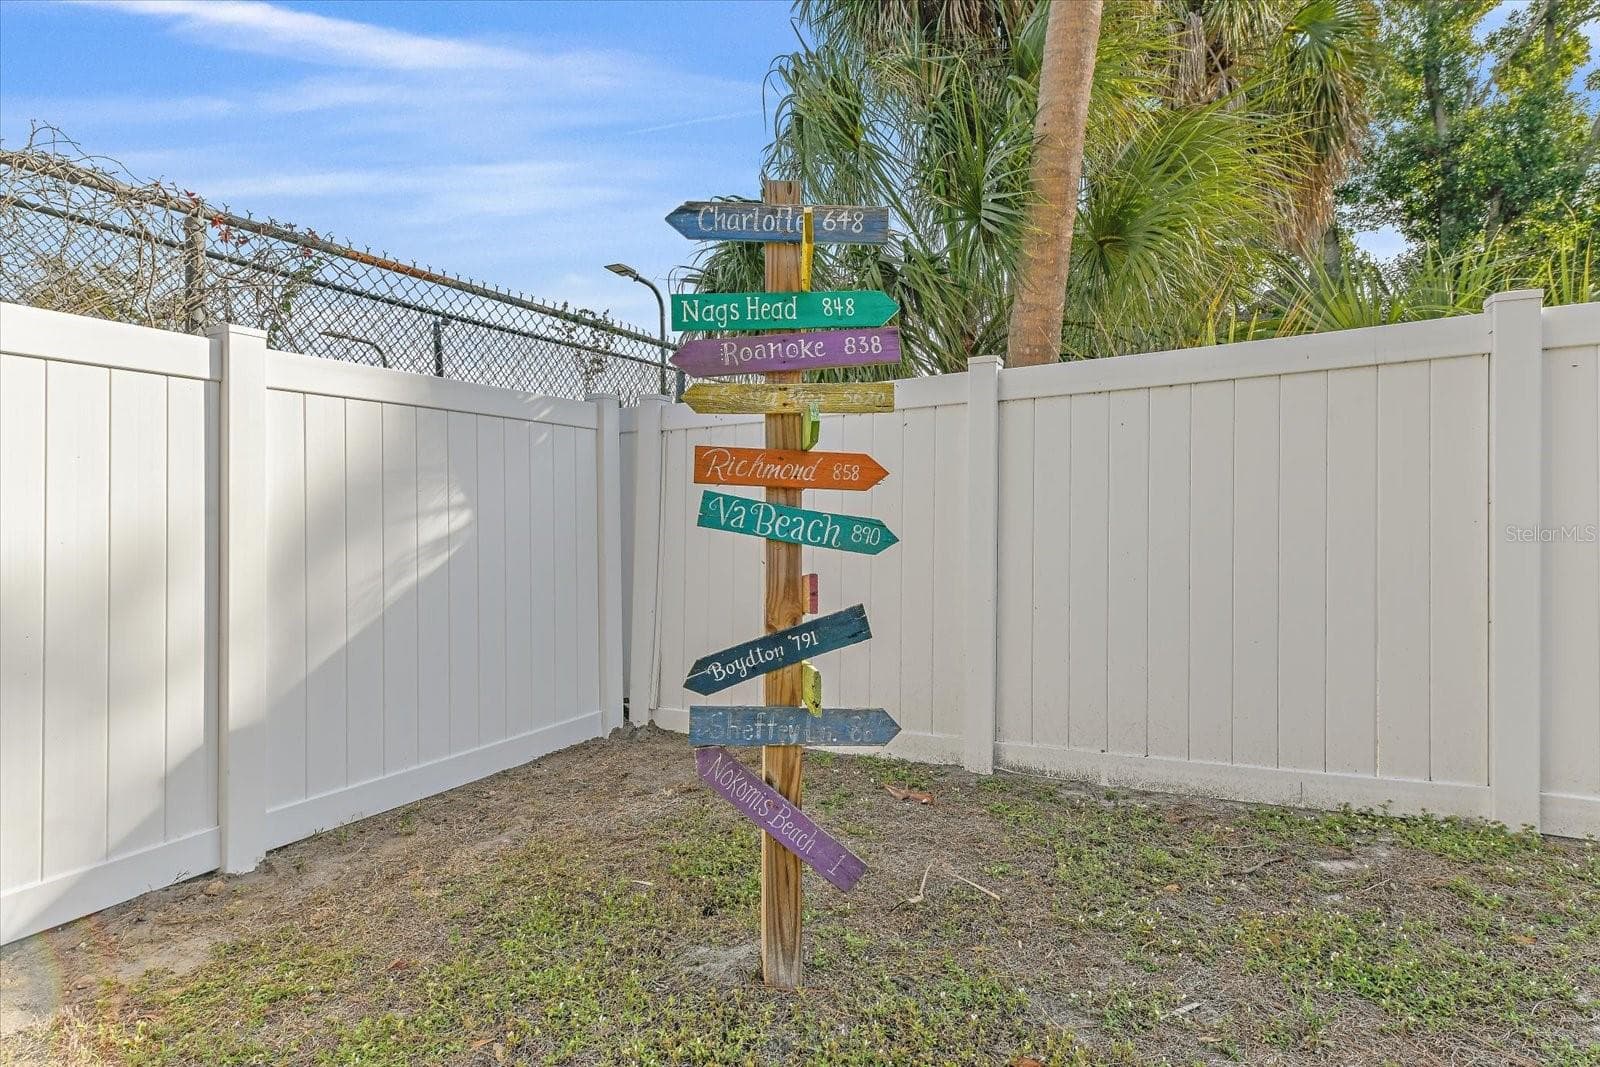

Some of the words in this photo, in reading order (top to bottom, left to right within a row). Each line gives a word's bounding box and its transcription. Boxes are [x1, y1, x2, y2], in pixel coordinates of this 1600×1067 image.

[822, 210, 865, 234] 648
[681, 300, 739, 328] Nags
[746, 296, 798, 321] Head
[822, 298, 855, 317] 848
[720, 339, 827, 367] Roanoke
[844, 335, 884, 355] 838
[702, 447, 824, 482] Richmond
[832, 462, 860, 481] 858
[708, 496, 746, 529] Va
[750, 502, 841, 547] Beach
[851, 524, 881, 546] 890
[706, 644, 785, 682] Boydton
[702, 752, 774, 817] Nokomis
[767, 804, 818, 855] Beach
[827, 854, 847, 876] 1
